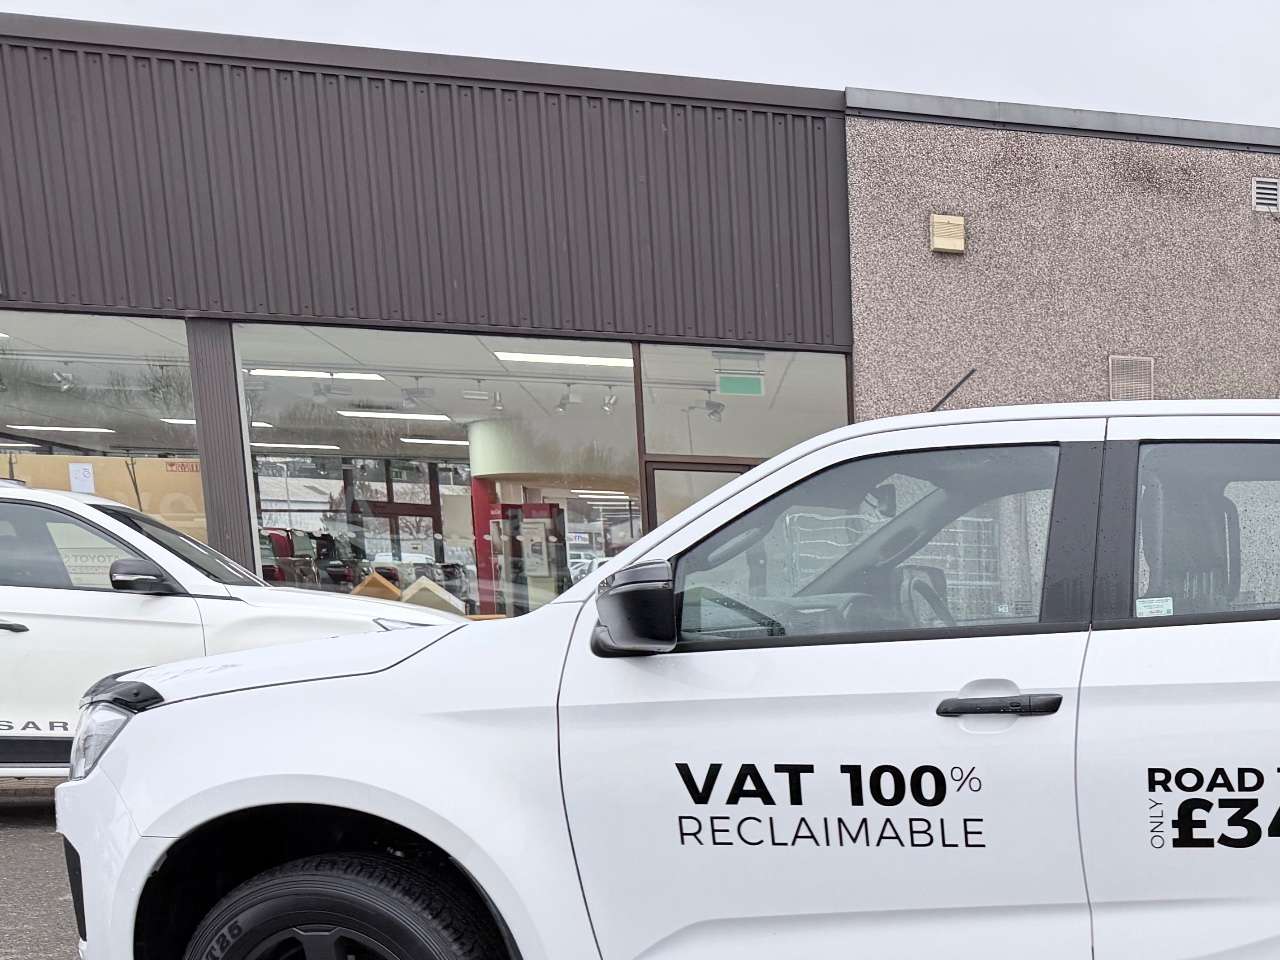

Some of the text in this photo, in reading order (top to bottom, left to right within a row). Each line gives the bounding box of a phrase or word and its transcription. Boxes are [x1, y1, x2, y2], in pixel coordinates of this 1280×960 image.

[675, 763, 983, 808] VAT 100%
[1147, 767, 1265, 793] ROAD
[678, 815, 987, 848] RECLAIMABLE
[1148, 798, 1165, 849] ONLY
